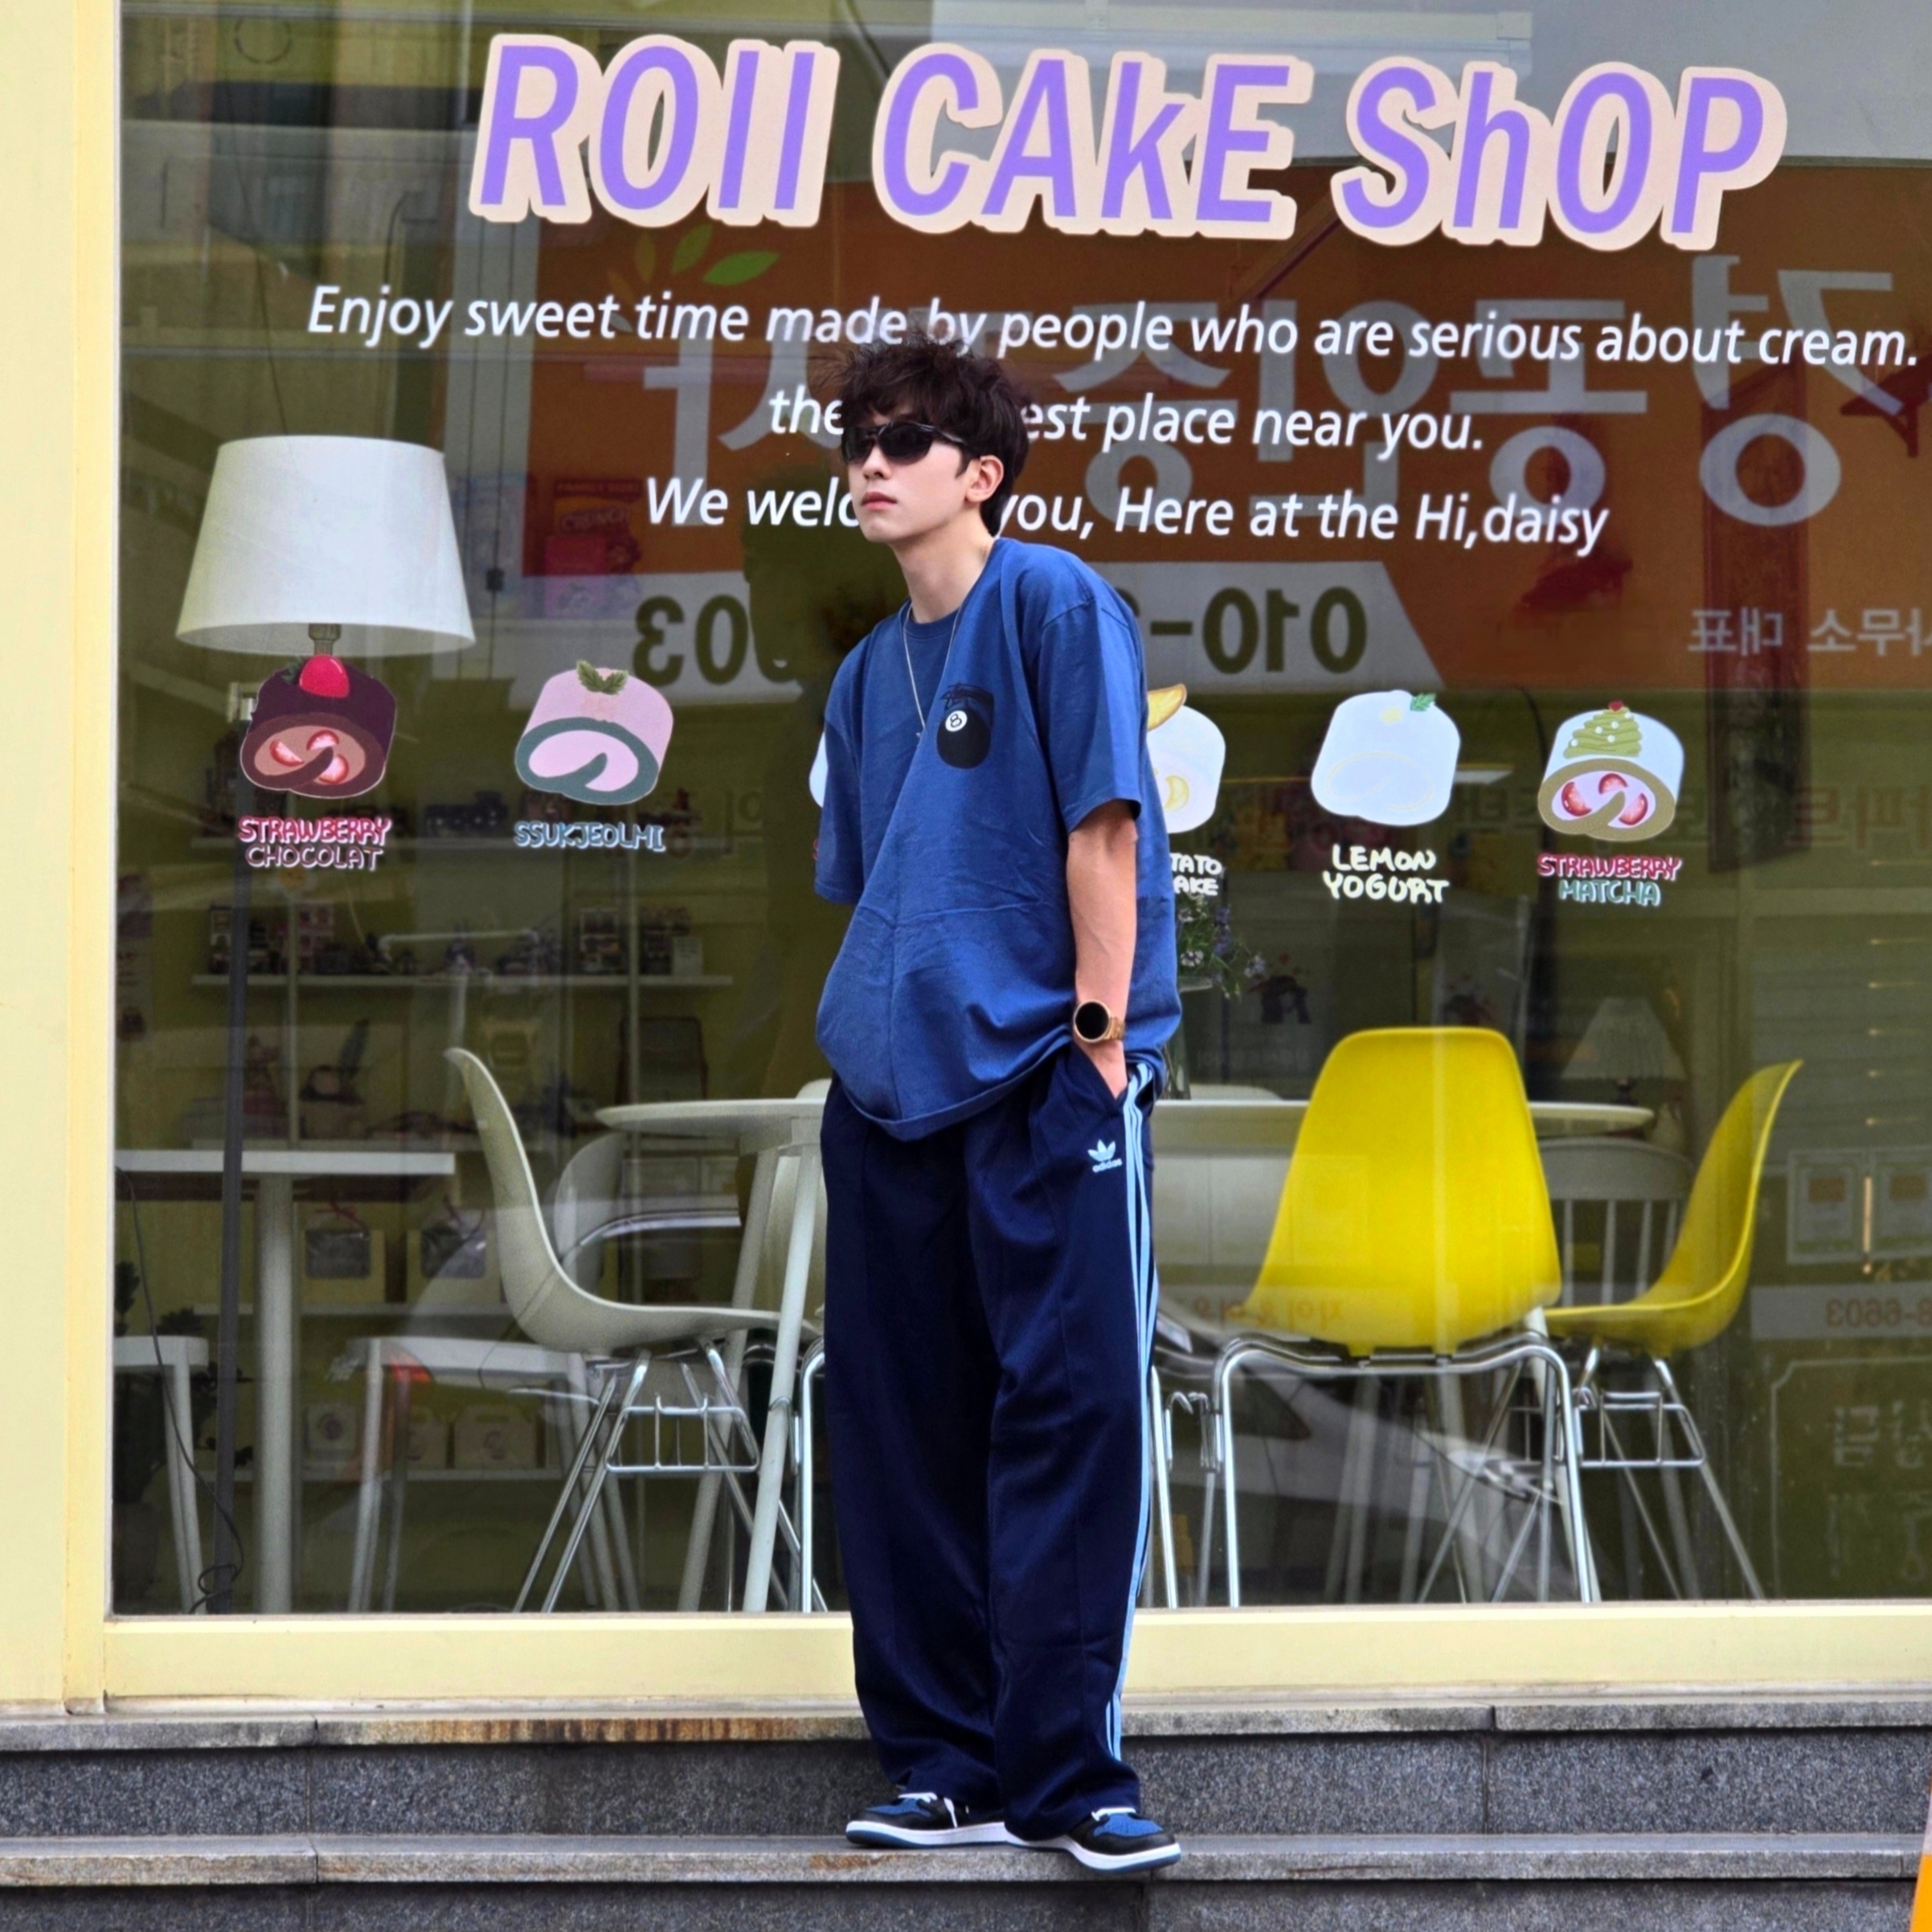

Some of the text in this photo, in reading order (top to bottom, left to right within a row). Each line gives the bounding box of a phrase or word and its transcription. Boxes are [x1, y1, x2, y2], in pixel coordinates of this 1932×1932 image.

[308, 284, 1918, 366] Enjoy sweet time made by people who are serious about cream.
[768, 383, 1482, 461] the est place near you.
[647, 477, 729, 526] We
[746, 476, 860, 527] welc
[1115, 486, 1234, 536] Here
[1249, 493, 1303, 538] at
[1316, 489, 1398, 540] the
[1415, 492, 1609, 557] Hi,daisy
[239, 816, 392, 846] STRAWBERRY
[514, 821, 667, 853] SSUKJEOLMI
[245, 842, 385, 871] CHOCOLAT
[1169, 852, 1223, 876] TATO
[1332, 844, 1437, 872] LEMON
[1538, 853, 1683, 882] STRAWBERRY
[1173, 874, 1219, 896] AKE
[1322, 870, 1450, 904] YOGURT
[1558, 878, 1662, 907] MATCHA
